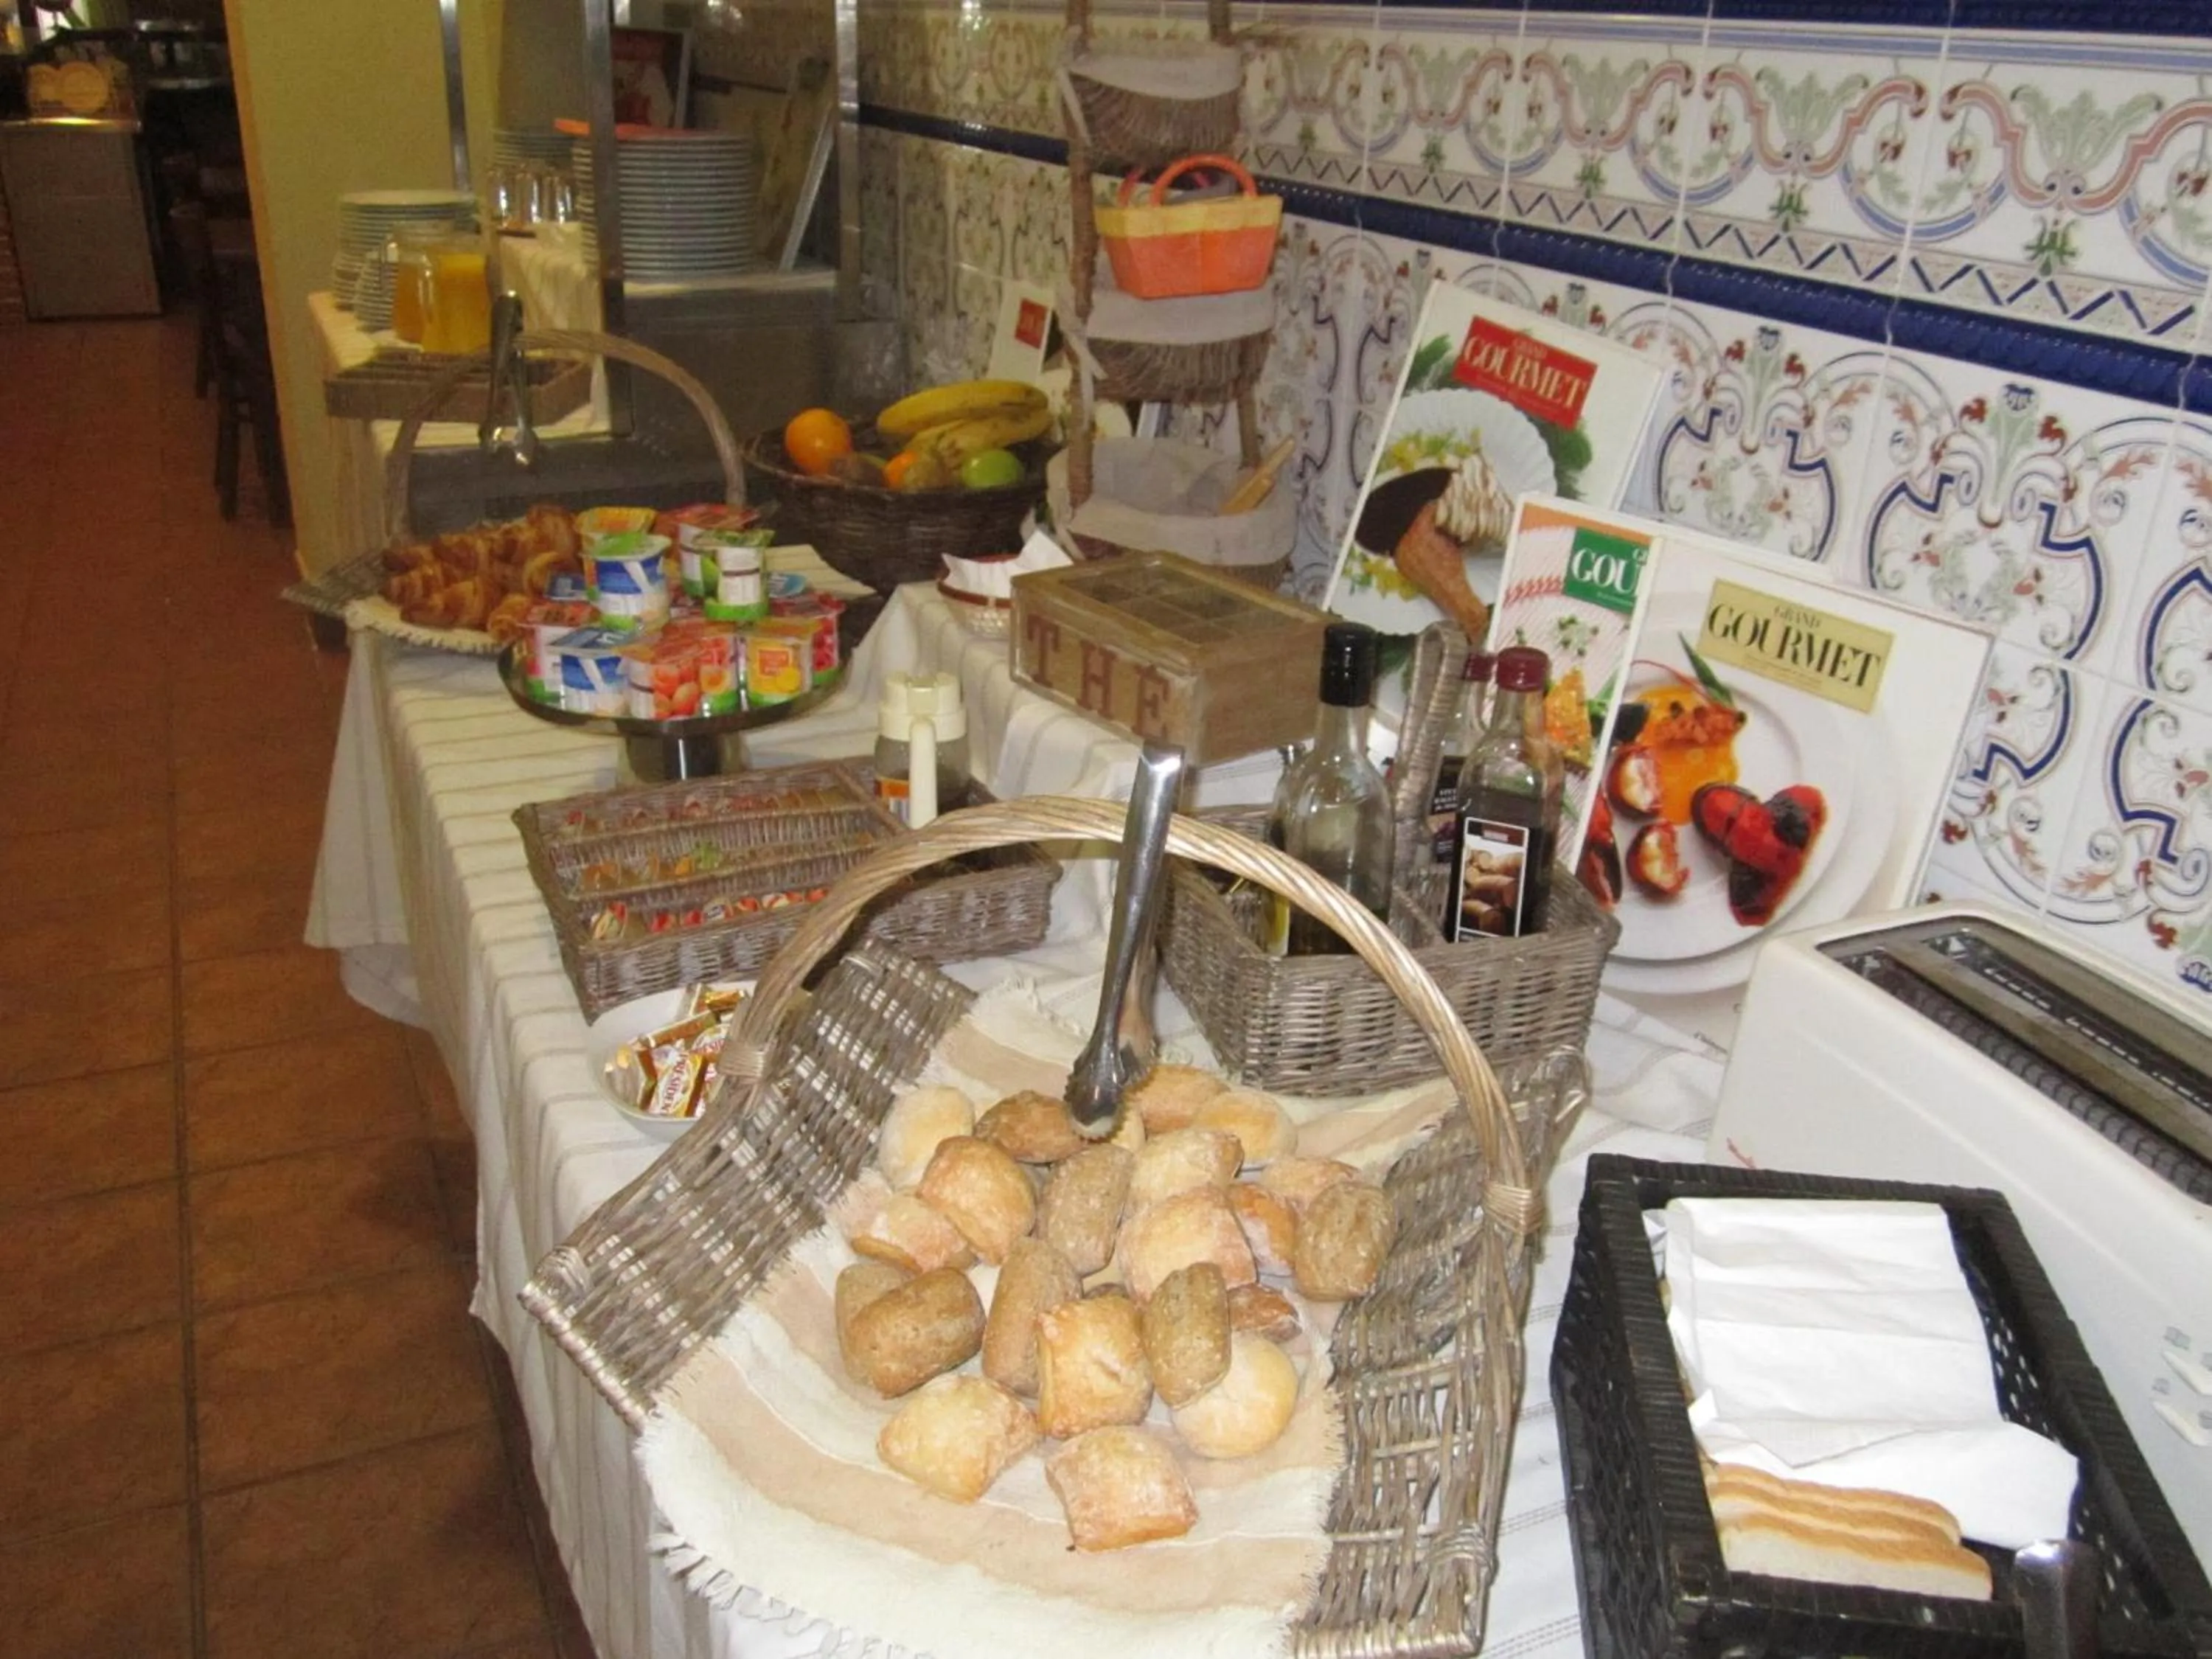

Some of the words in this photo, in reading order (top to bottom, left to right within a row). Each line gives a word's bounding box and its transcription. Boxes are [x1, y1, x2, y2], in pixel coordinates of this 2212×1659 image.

[1464, 336, 1587, 408] GOURMET
[1708, 604, 1882, 686] GOURMET
[1774, 605, 1822, 628] GRAND
